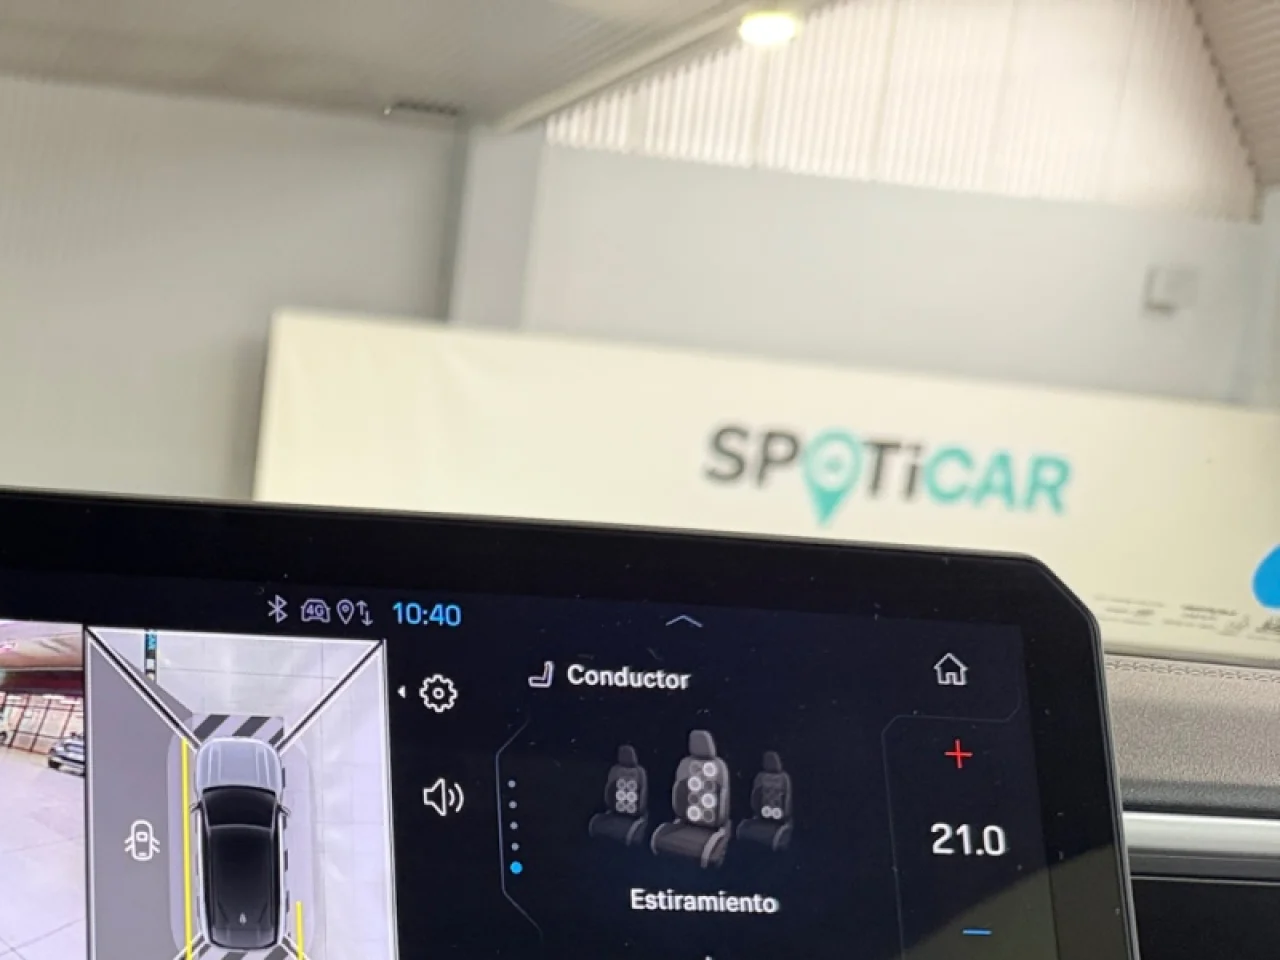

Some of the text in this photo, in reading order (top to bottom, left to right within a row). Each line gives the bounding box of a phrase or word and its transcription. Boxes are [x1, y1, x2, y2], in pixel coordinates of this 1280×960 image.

[392, 602, 462, 627] 10:40
[567, 663, 692, 690] Conductor
[930, 822, 1007, 857] 21.0
[630, 887, 780, 914] Estiramiento
